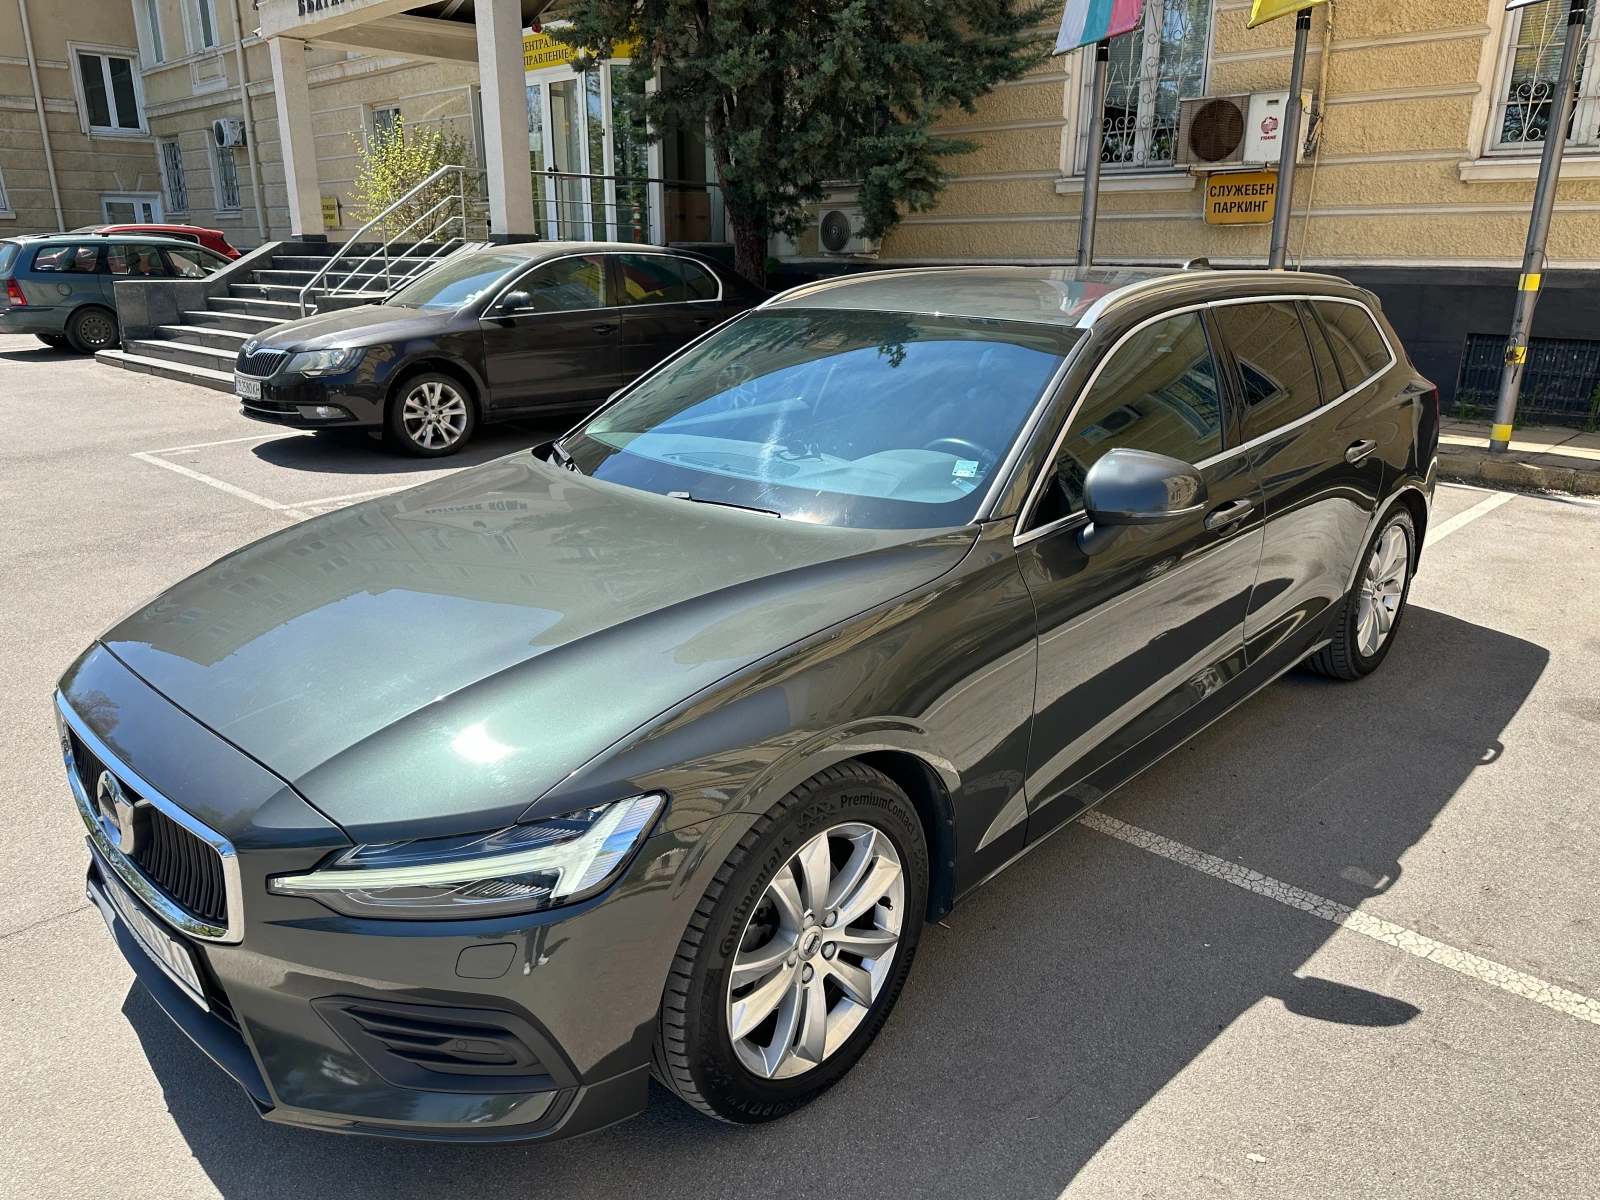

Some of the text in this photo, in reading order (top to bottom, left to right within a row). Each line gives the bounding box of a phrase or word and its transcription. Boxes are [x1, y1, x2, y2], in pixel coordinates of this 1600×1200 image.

[524, 48, 569, 66] ПРАВЛЕНИЕ
[1210, 183, 1274, 197] СЛУЖЕБЕН
[1213, 200, 1268, 213] ПАРКИНГ
[840, 791, 915, 835] PremiumContact
[719, 846, 783, 958] Continental
